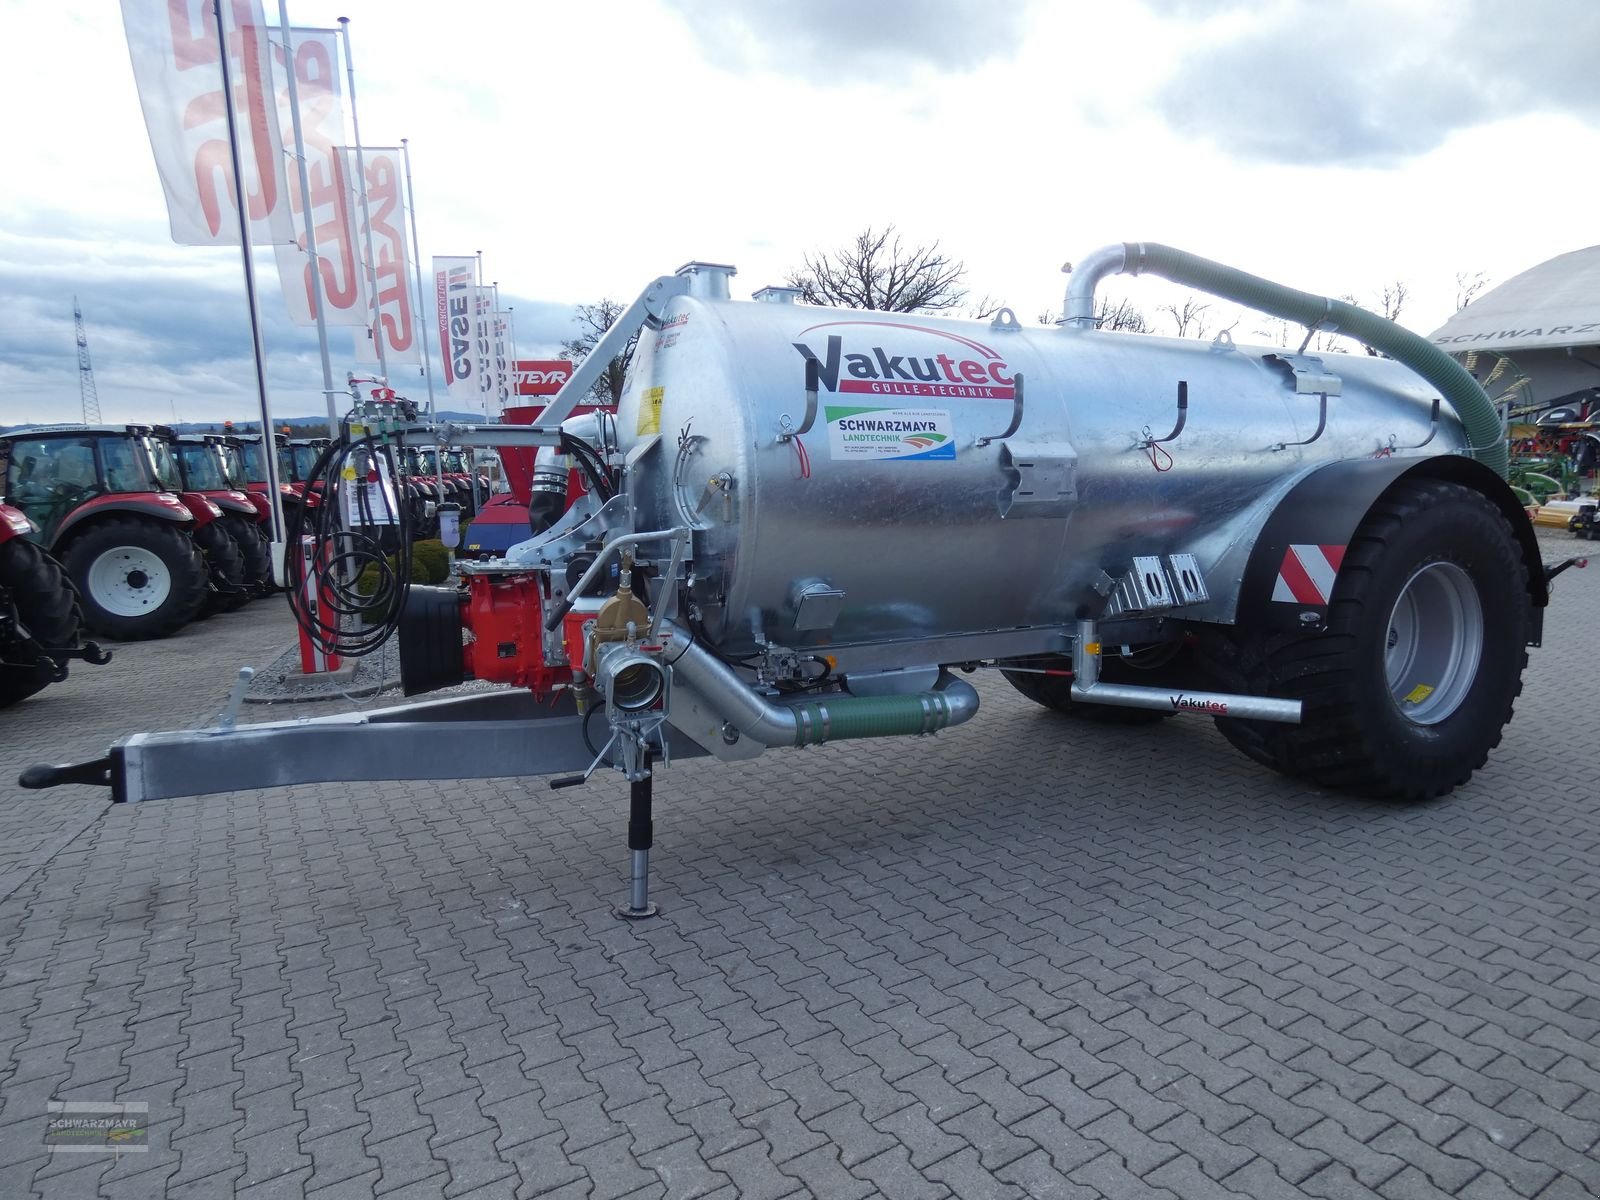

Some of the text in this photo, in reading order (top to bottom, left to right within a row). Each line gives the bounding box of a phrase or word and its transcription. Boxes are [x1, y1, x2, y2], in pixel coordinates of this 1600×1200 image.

[1433, 322, 1600, 345] SCHWARZ
[792, 335, 1015, 393] Vakutec
[871, 382, 994, 398] GÜLLE-TECHNIK
[838, 419, 937, 432] SCHWARZMAYR
[842, 433, 902, 442] LANDTECHNIK
[1170, 694, 1228, 711] Vakutec
